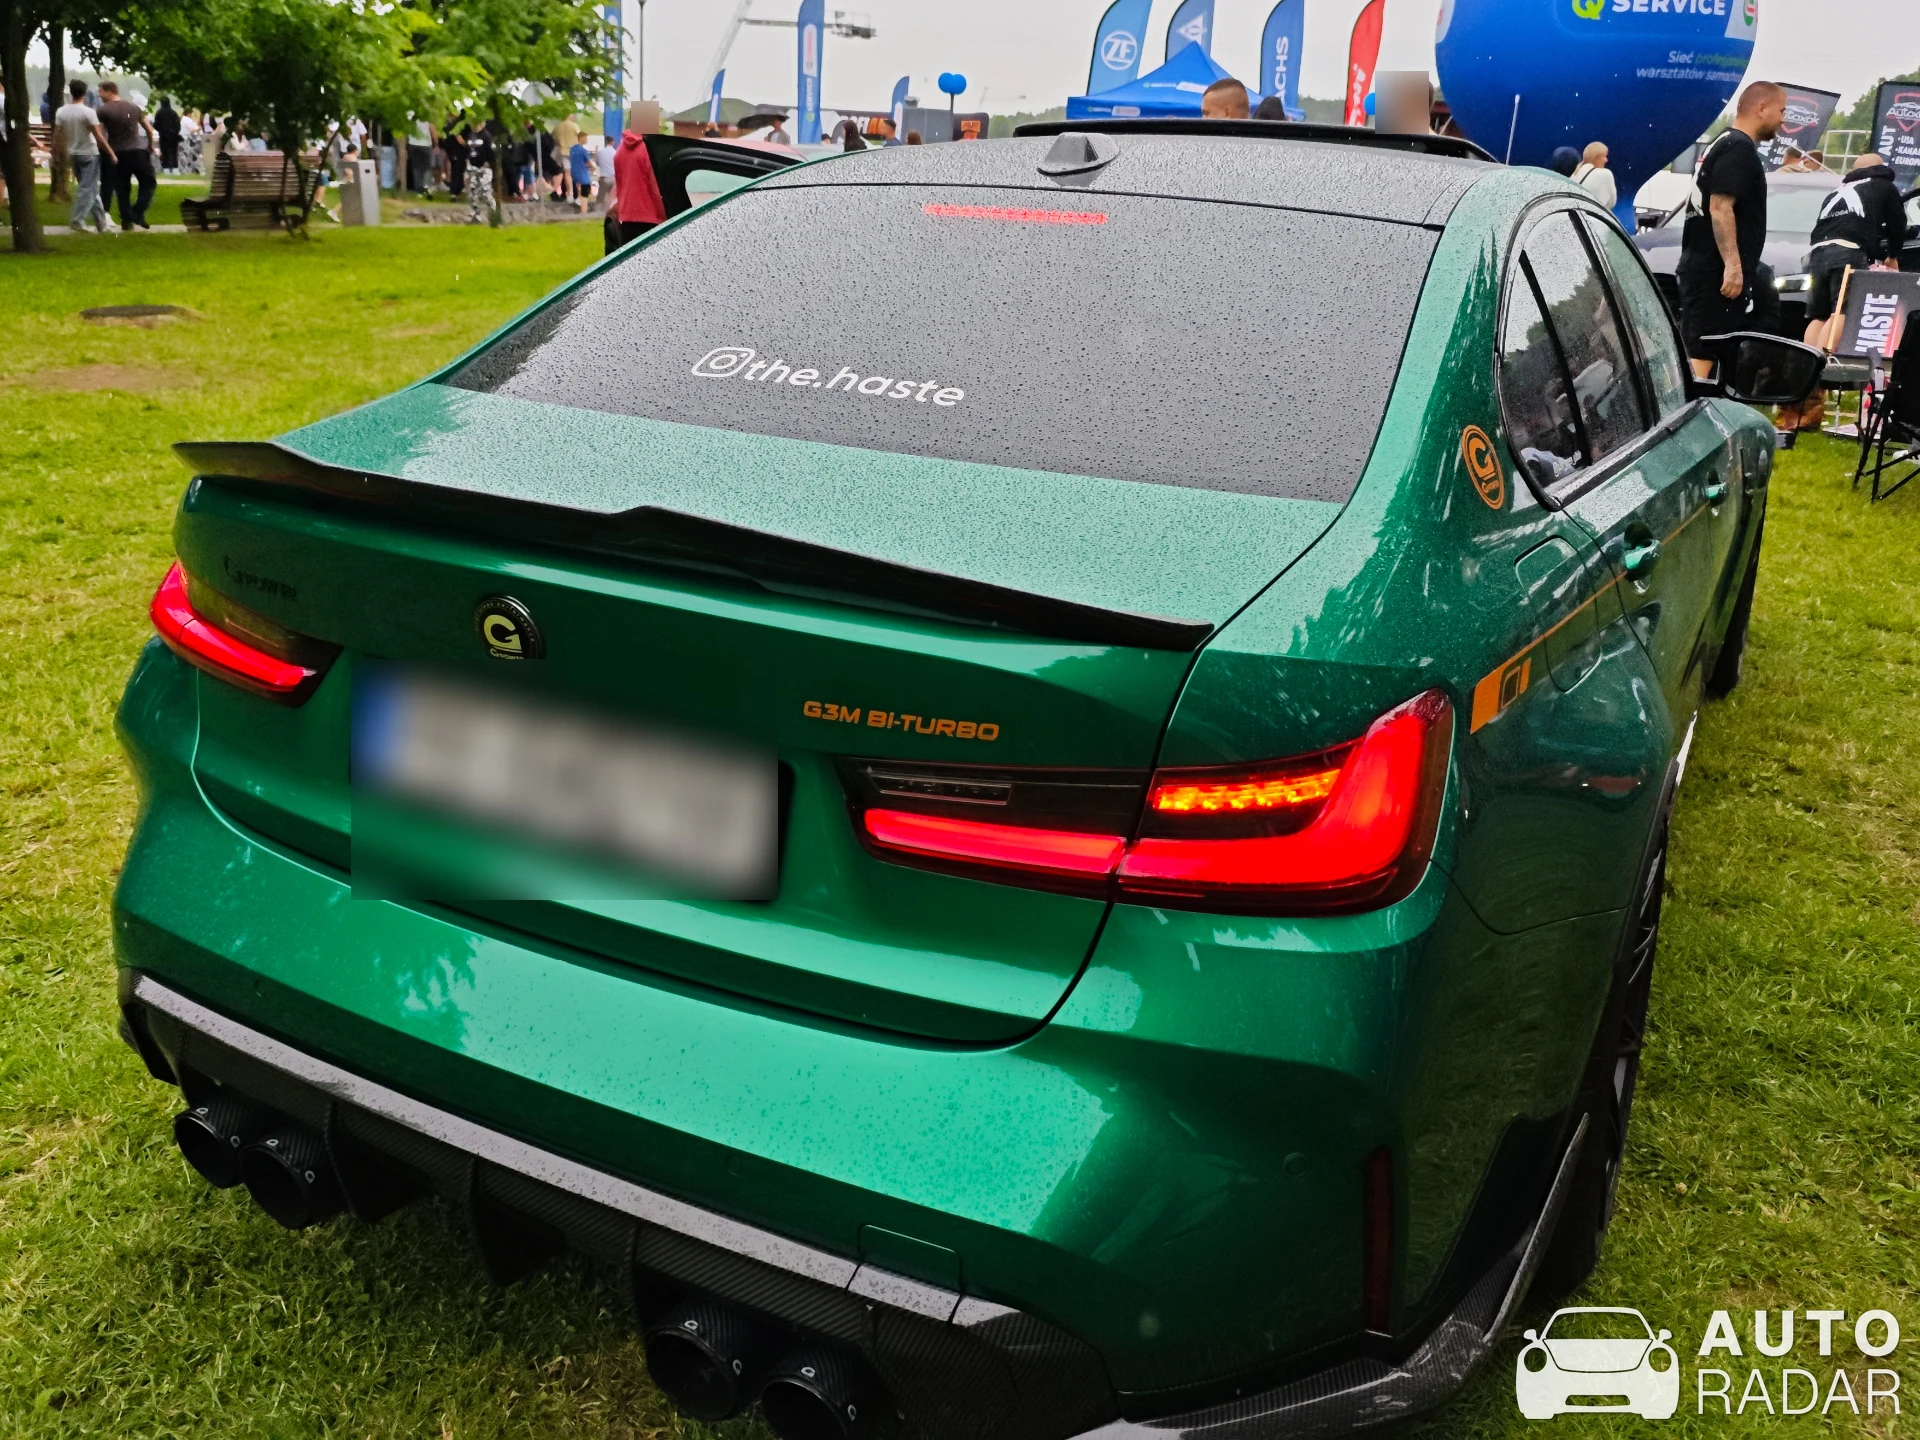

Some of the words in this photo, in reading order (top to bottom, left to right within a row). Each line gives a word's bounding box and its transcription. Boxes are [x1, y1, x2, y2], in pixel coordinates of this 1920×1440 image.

[1612, 0, 1726, 15] SERVICE
[1274, 36, 1289, 108] ACHS
[1636, 65, 1705, 80] warsztatów
[1668, 50, 1694, 64] Sieć
[1855, 293, 1898, 354] HASTE
[483, 614, 522, 650] G
[803, 700, 861, 724] G3M
[867, 710, 1000, 741] BI-TURBO
